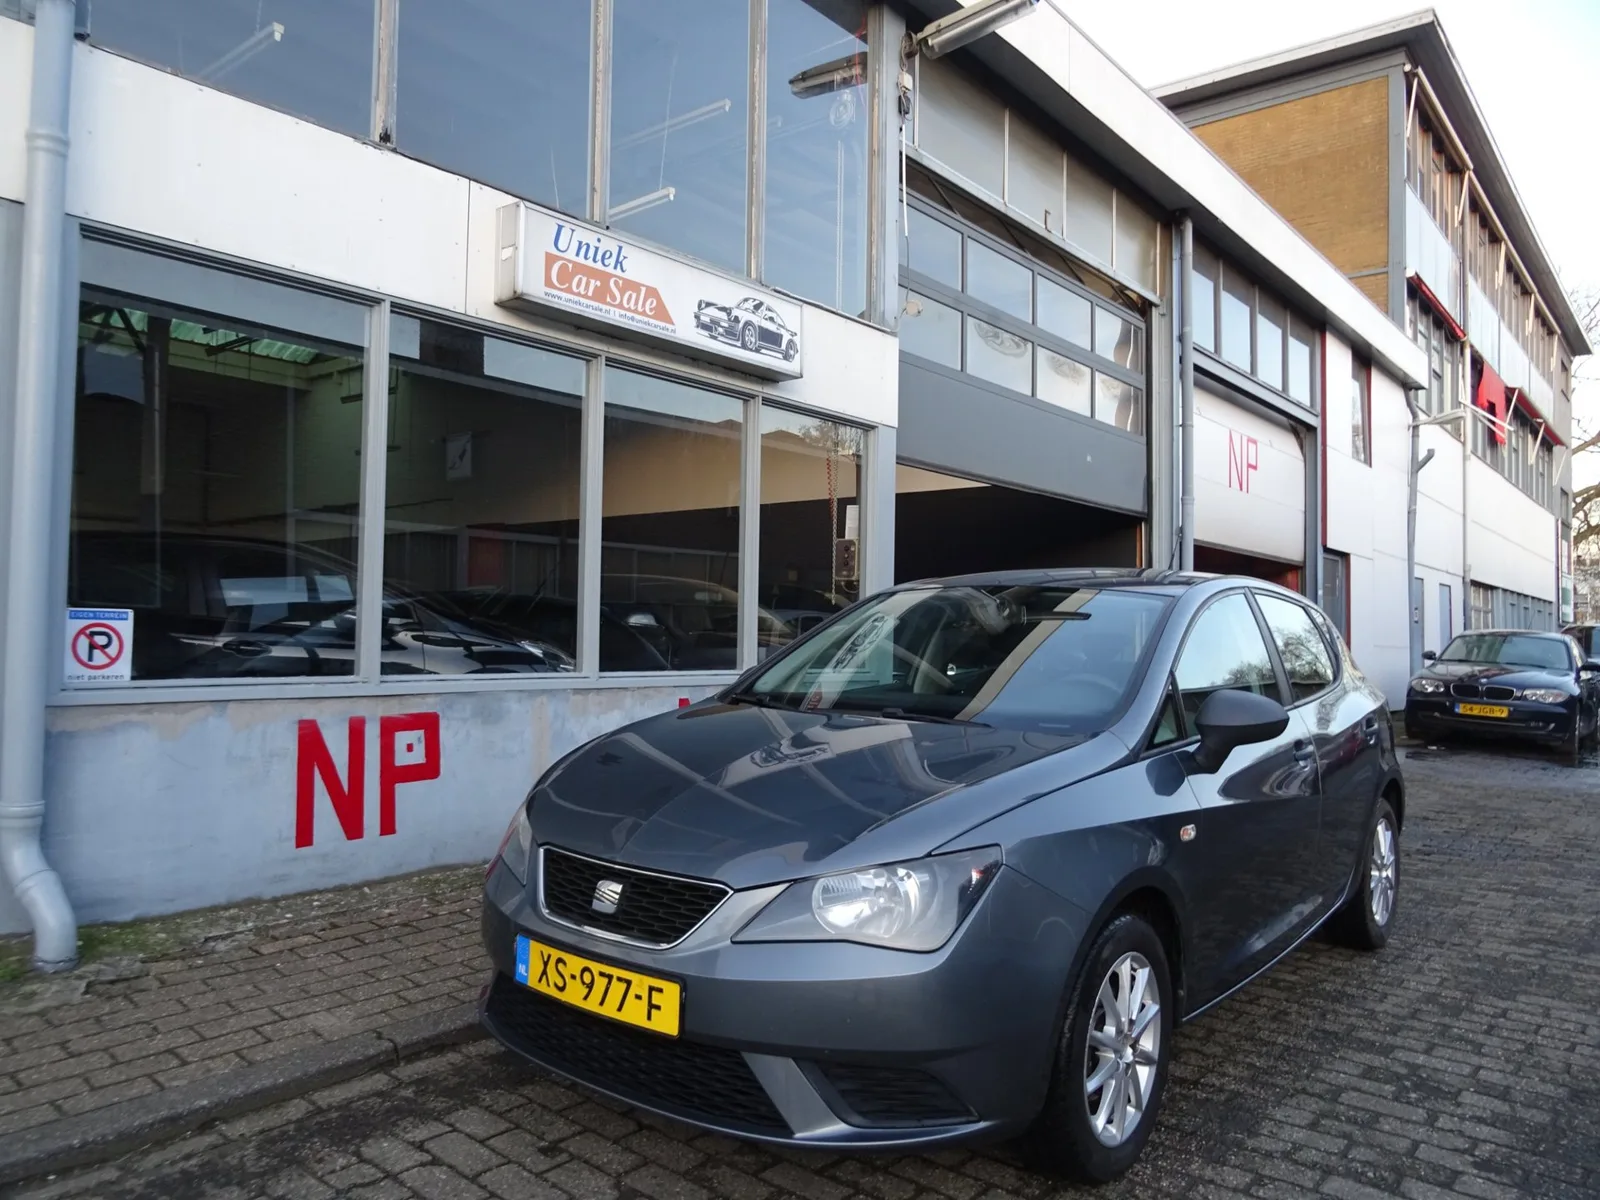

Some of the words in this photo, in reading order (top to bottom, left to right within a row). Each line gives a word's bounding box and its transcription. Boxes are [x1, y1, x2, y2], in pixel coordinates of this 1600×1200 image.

[553, 222, 629, 273] Uniek
[543, 290, 611, 316] www.uniekcarsale.nl
[618, 312, 677, 334] info@uniekcarsale.nl
[551, 260, 601, 297] Car
[606, 277, 657, 316] Sale
[1228, 428, 1258, 494] NP
[71, 611, 94, 619] EIGEN
[96, 612, 128, 620] TERREIN
[87, 674, 125, 682] parkeren
[295, 711, 441, 850] NP
[518, 963, 528, 977] NL
[537, 950, 664, 1022] XS-977-F
